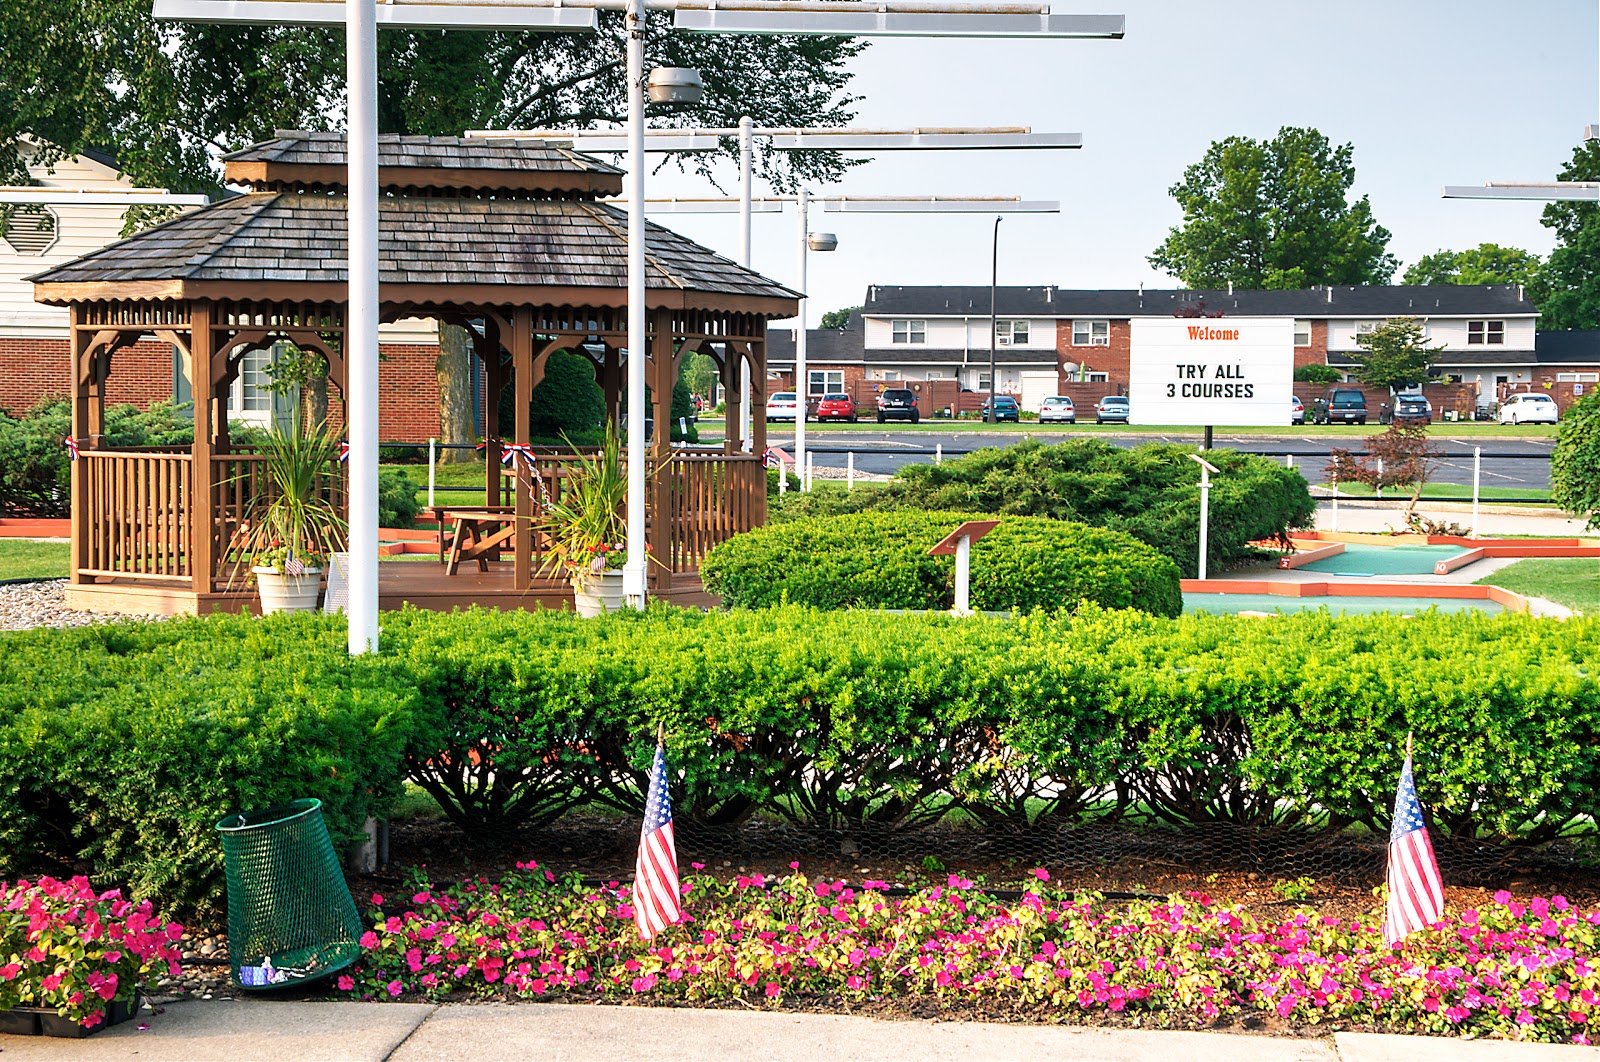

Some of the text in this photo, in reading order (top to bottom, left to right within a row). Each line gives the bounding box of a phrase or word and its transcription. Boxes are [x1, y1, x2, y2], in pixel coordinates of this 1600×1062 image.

[1187, 326, 1239, 340] Welcome
[1176, 364, 1245, 379] TRY ALL
[1167, 383, 1254, 398] 3 COURSES
[1436, 563, 1447, 572] 10
